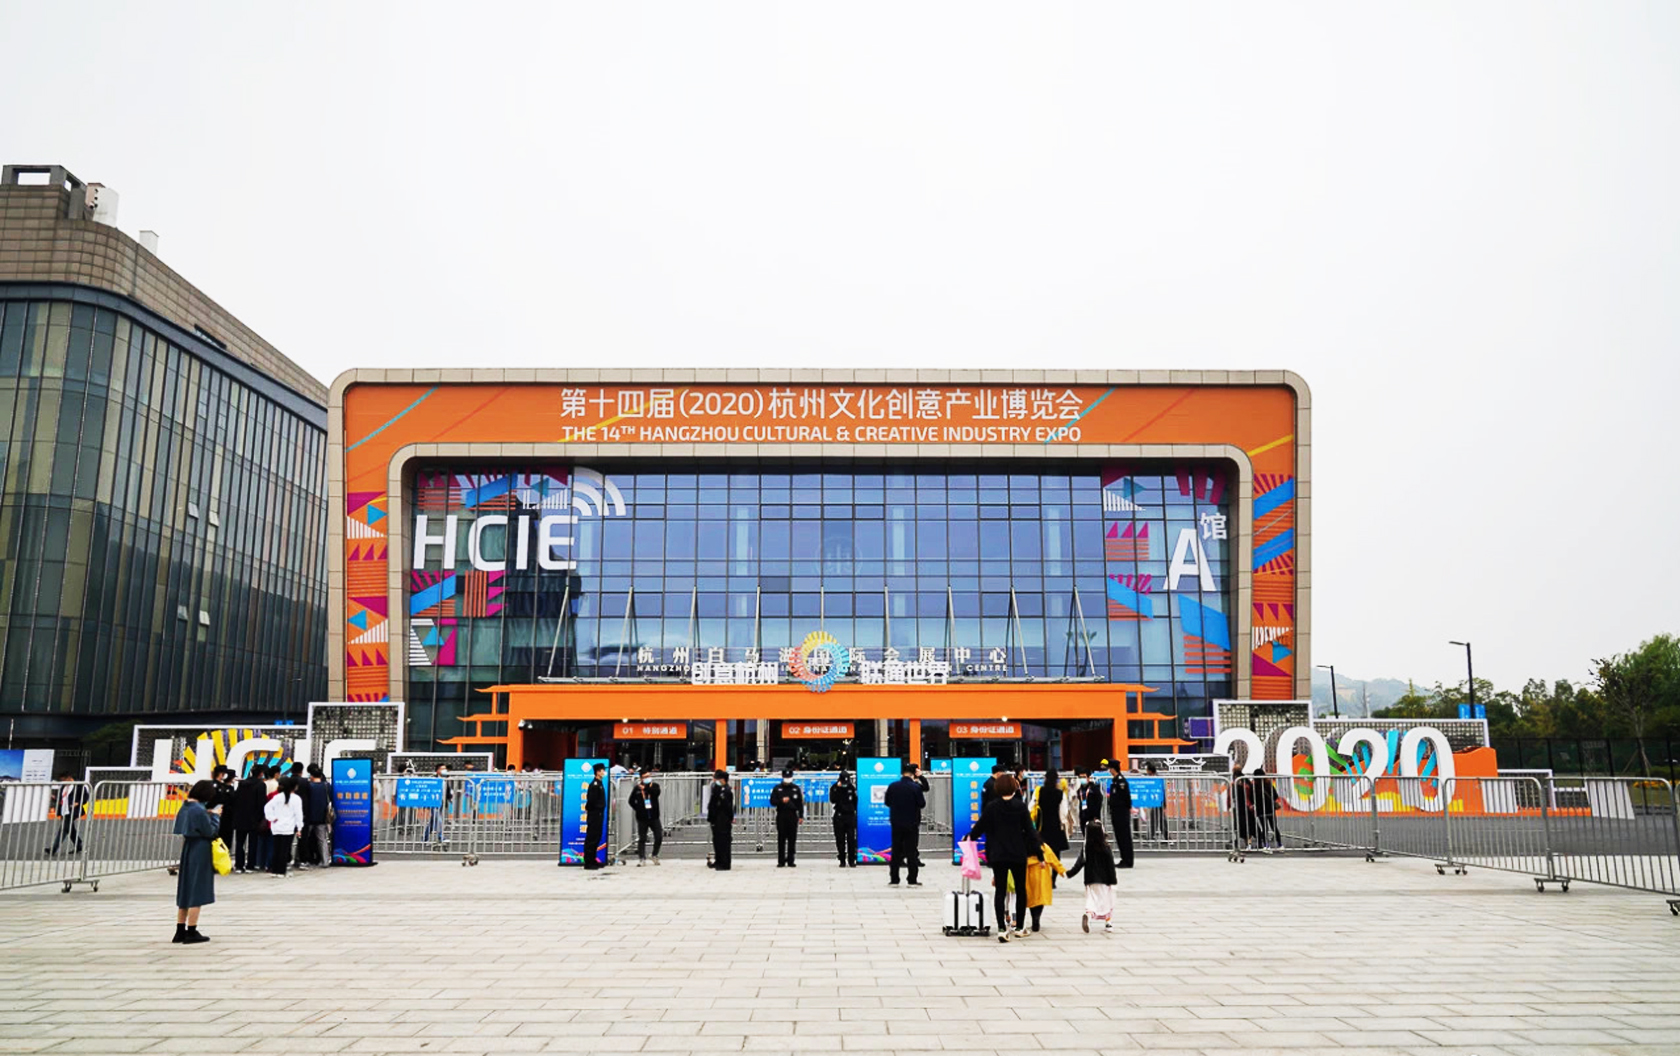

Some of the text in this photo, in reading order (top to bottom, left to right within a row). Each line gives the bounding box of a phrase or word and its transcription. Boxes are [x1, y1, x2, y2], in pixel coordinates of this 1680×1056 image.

[560, 388, 1083, 420] 第十四届(2020)杭州文化创意产业博览会
[562, 426, 1081, 442] THE 14TH HANGZHOU CULTURAL & CREATIVE INDUSTRY EXPO
[1200, 512, 1227, 540] 馆
[413, 514, 579, 571] HCIE
[637, 664, 1008, 673] HANGZHO CENTRE
[622, 726, 633, 735] 01
[788, 726, 800, 735] 02
[956, 725, 968, 734] 03
[1213, 726, 1456, 812] 2020
